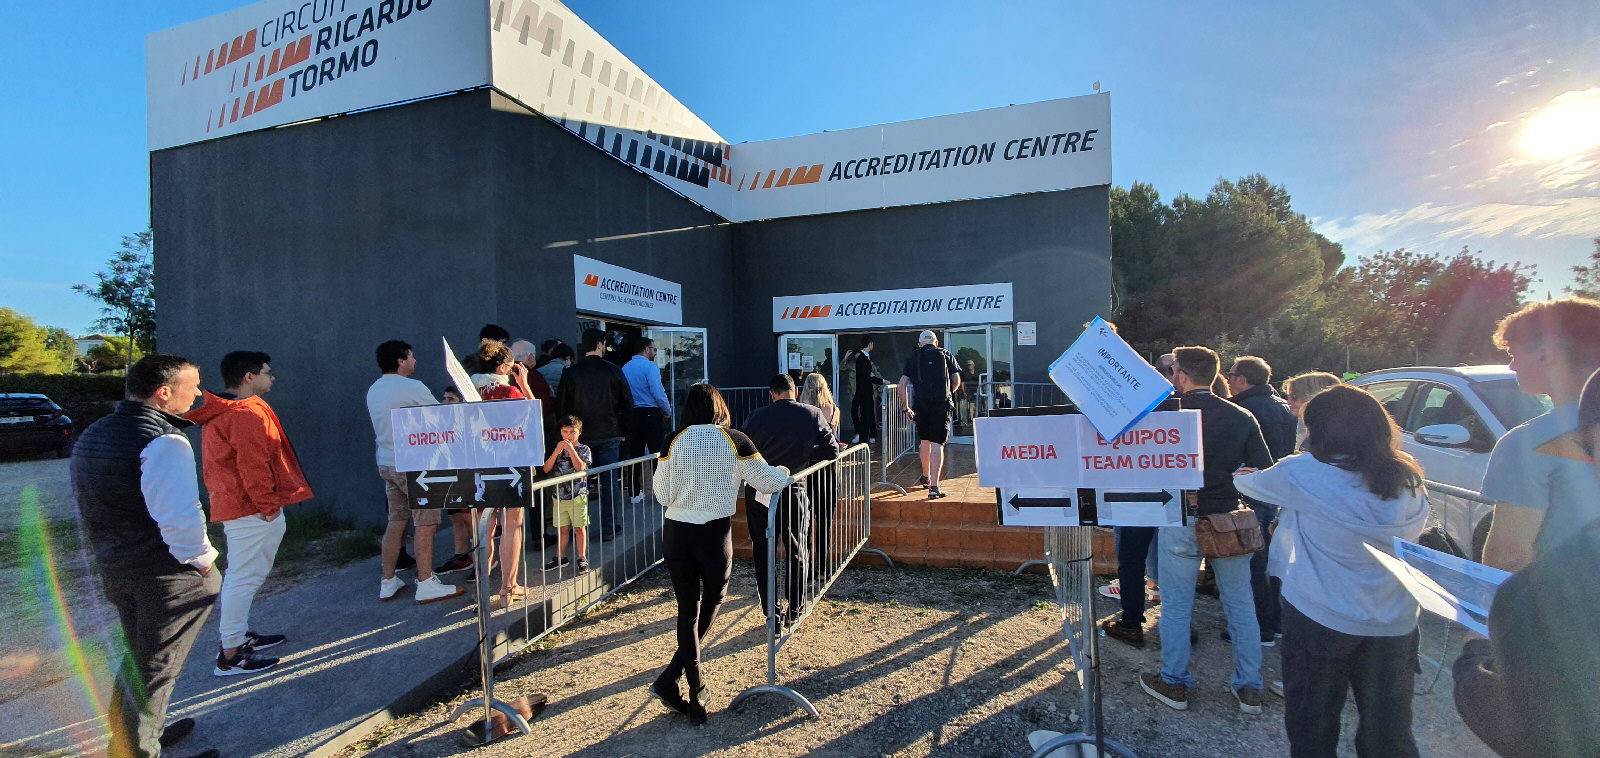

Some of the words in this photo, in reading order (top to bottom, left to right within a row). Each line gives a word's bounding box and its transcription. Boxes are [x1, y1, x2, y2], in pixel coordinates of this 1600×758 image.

[289, 39, 379, 98] TORMO
[827, 142, 997, 182] ACCREDITATION
[1003, 129, 1098, 161] CENTRE
[599, 292, 616, 301] CENTRO
[600, 277, 655, 300] ACCREDITATION
[655, 290, 678, 305] CENTRE
[834, 298, 943, 317] ACCREDITATION
[947, 295, 1005, 312] CENTRE
[1097, 347, 1142, 391] IMPORTANTE
[408, 431, 456, 446] CIRCUIT
[482, 426, 525, 442] DORNA
[1001, 444, 1058, 460] MEDIA
[1082, 454, 1134, 470] TEAM
[1138, 453, 1200, 470] GUEST
